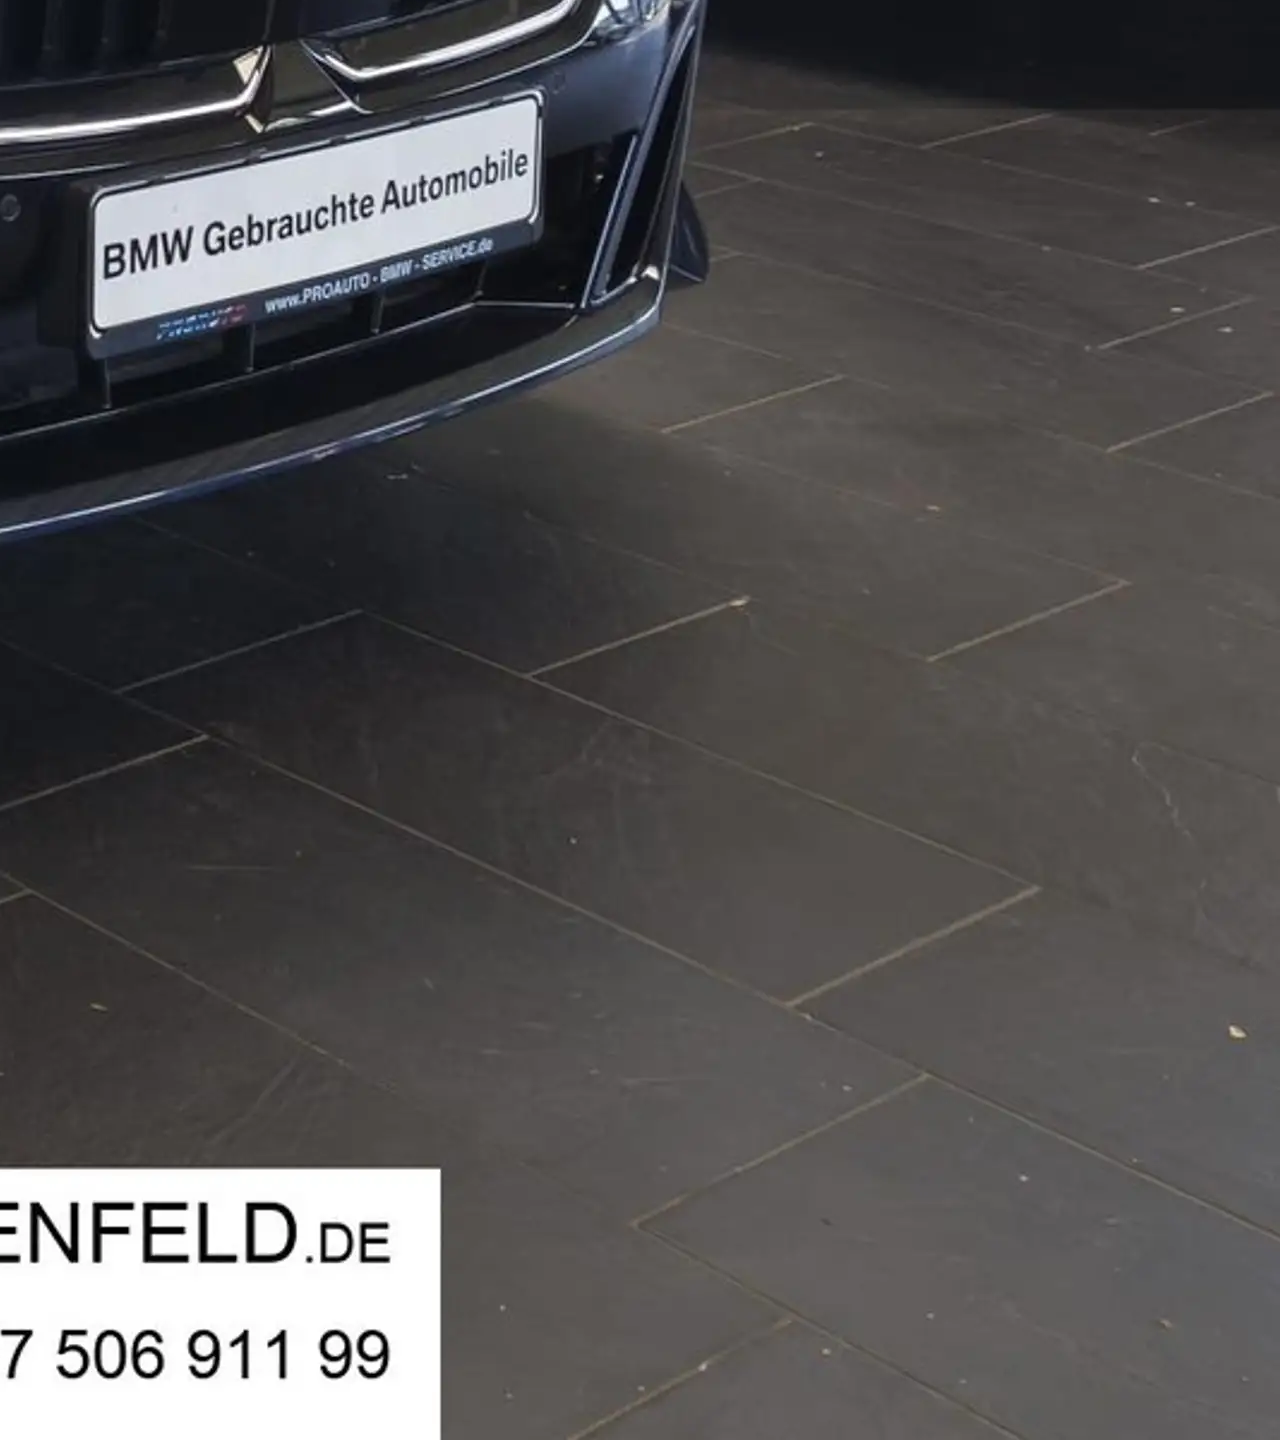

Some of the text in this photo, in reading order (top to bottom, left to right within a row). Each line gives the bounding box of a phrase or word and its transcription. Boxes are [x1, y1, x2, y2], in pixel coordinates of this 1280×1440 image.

[102, 149, 529, 280] BMW Gebrauchte Automobile
[380, 259, 415, 283] BMW
